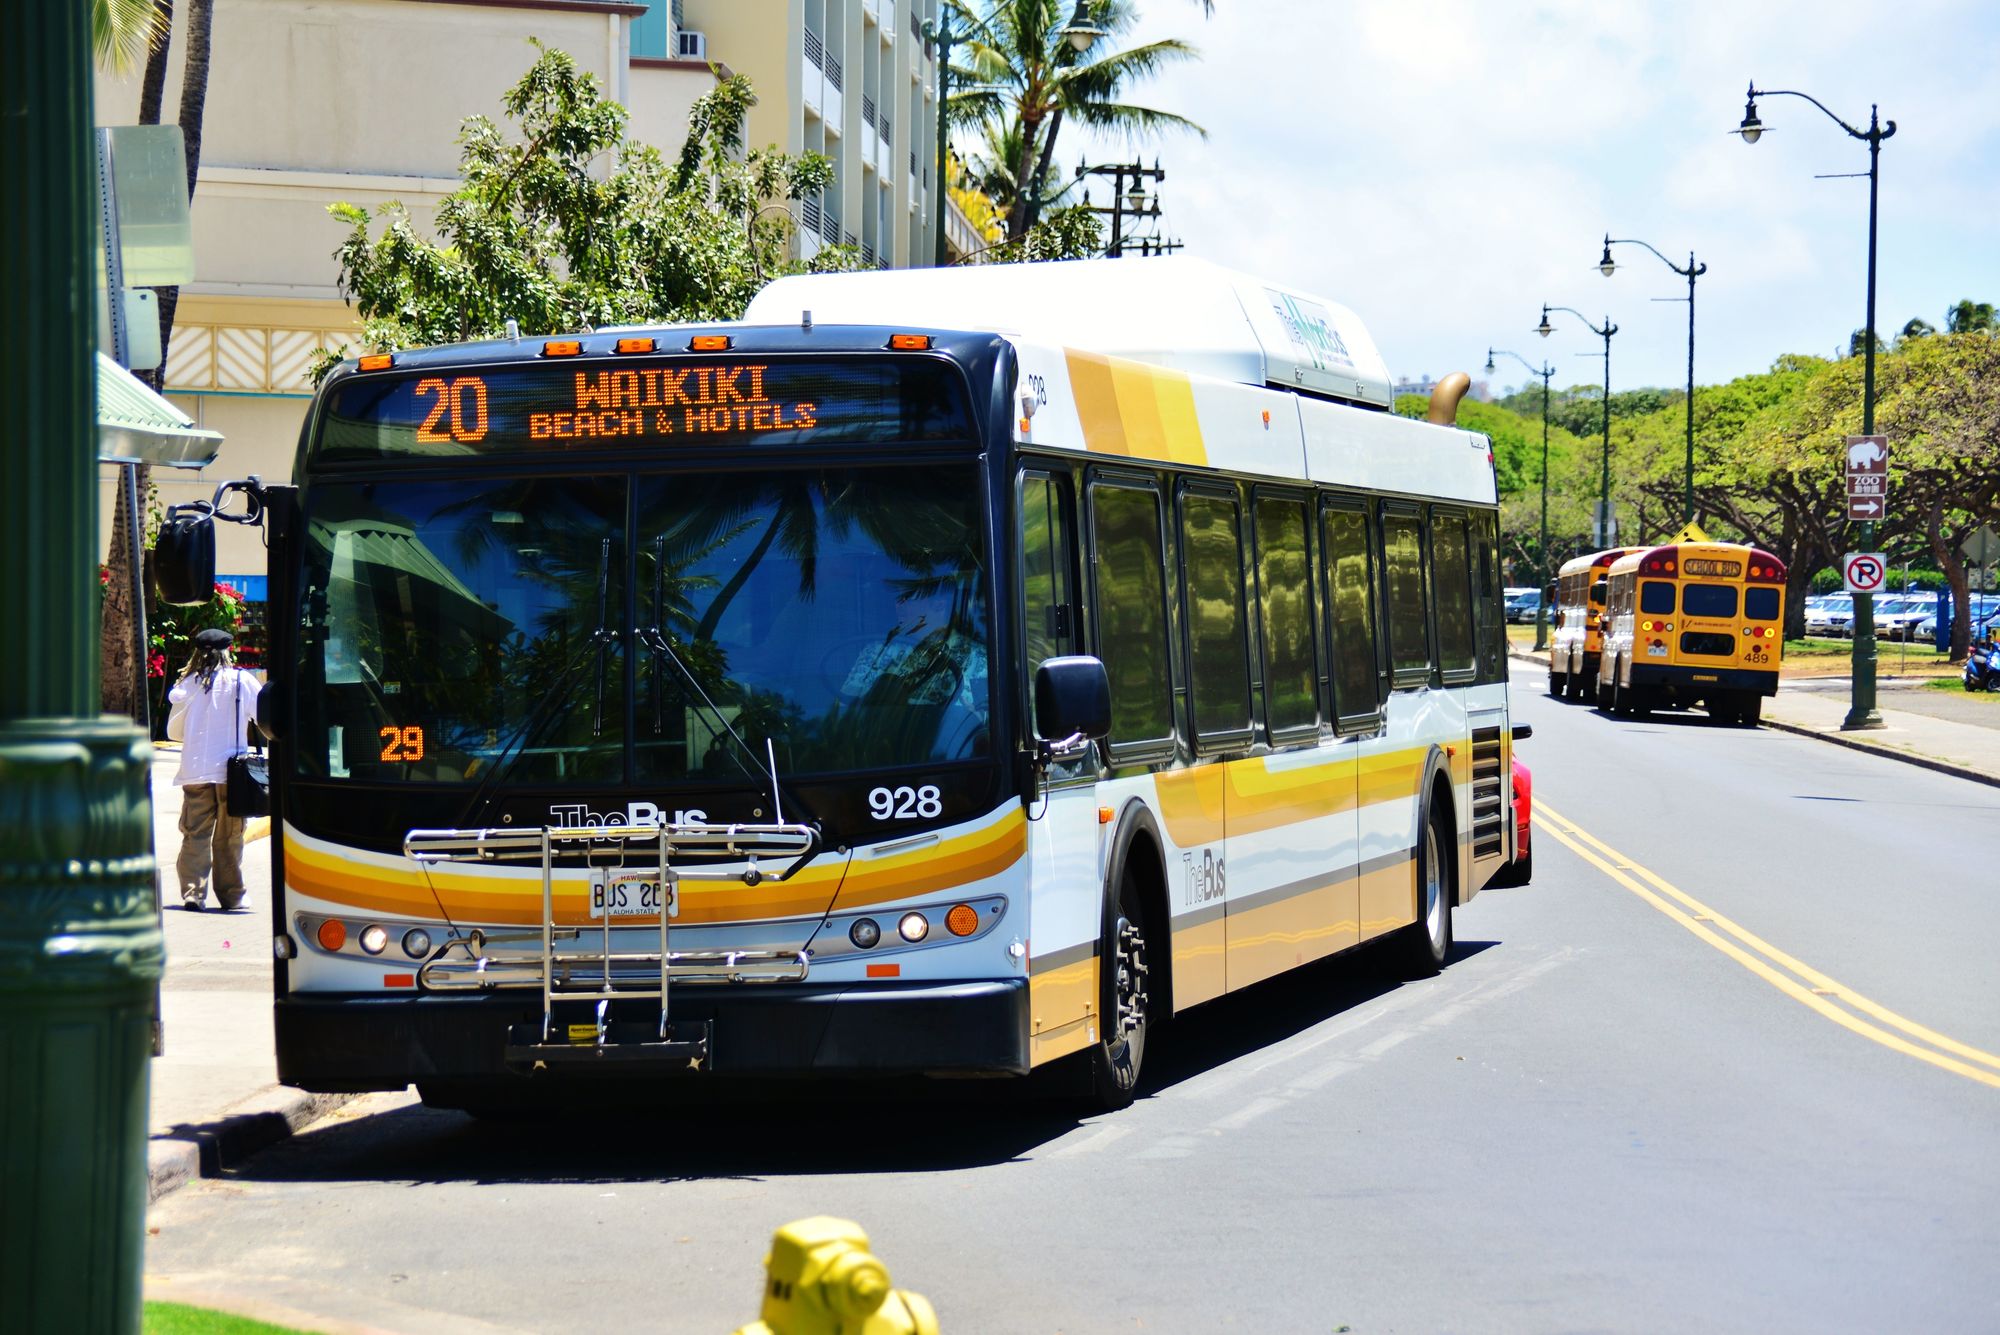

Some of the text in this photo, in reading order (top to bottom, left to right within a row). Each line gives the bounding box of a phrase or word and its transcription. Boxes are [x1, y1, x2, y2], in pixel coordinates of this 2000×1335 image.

[576, 365, 769, 409] WAIKIKI
[415, 376, 488, 443] 20
[530, 403, 816, 438] BEACH & HOTELS
[1854, 476, 1880, 485] ZOO
[1686, 560, 1740, 577] SCHOOL BUS
[1744, 653, 1769, 664] 489
[380, 726, 423, 761] 29
[868, 785, 942, 820] 928
[1183, 848, 1225, 906] TheBus
[594, 883, 628, 908] BUS
